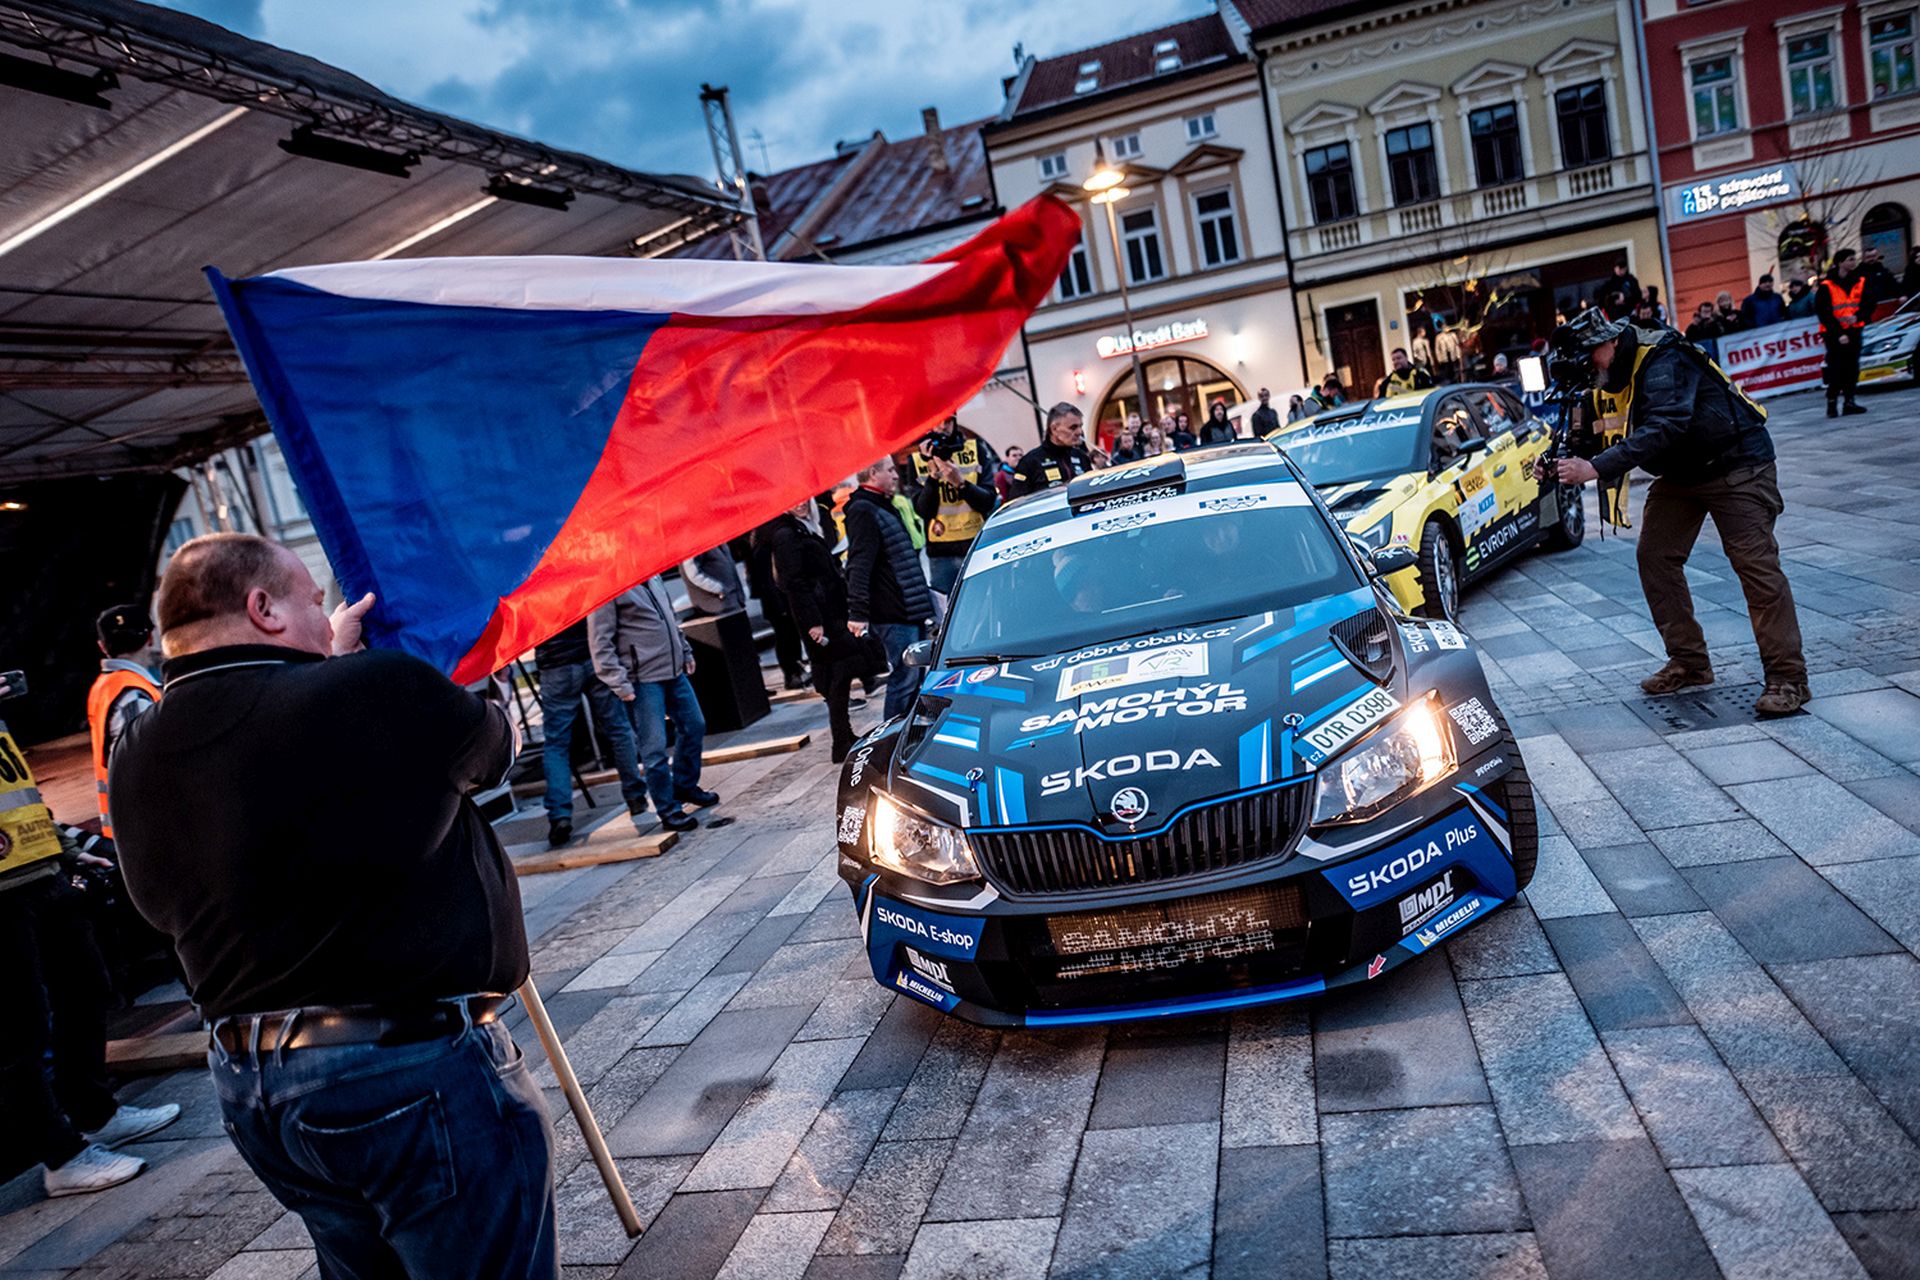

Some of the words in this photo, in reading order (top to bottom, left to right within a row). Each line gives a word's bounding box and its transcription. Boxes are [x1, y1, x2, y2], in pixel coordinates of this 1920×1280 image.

[1171, 319, 1207, 341] Bank
[957, 450, 976, 465] 162
[1479, 520, 1519, 559] EVROFIN
[1067, 641, 1131, 664] dobré
[1134, 627, 1233, 649] obaly.cz
[1019, 682, 1245, 733] SAMOHÝL
[1073, 695, 1248, 736] MOTOR
[1346, 691, 1393, 725] 0398
[1309, 750, 1325, 762] CZ
[1445, 824, 1478, 851] Plus
[1435, 898, 1481, 933] MICHELIN
[930, 925, 974, 950] E-shop
[1119, 928, 1275, 974] MOTOR
[909, 978, 945, 1003] MICHELIN
